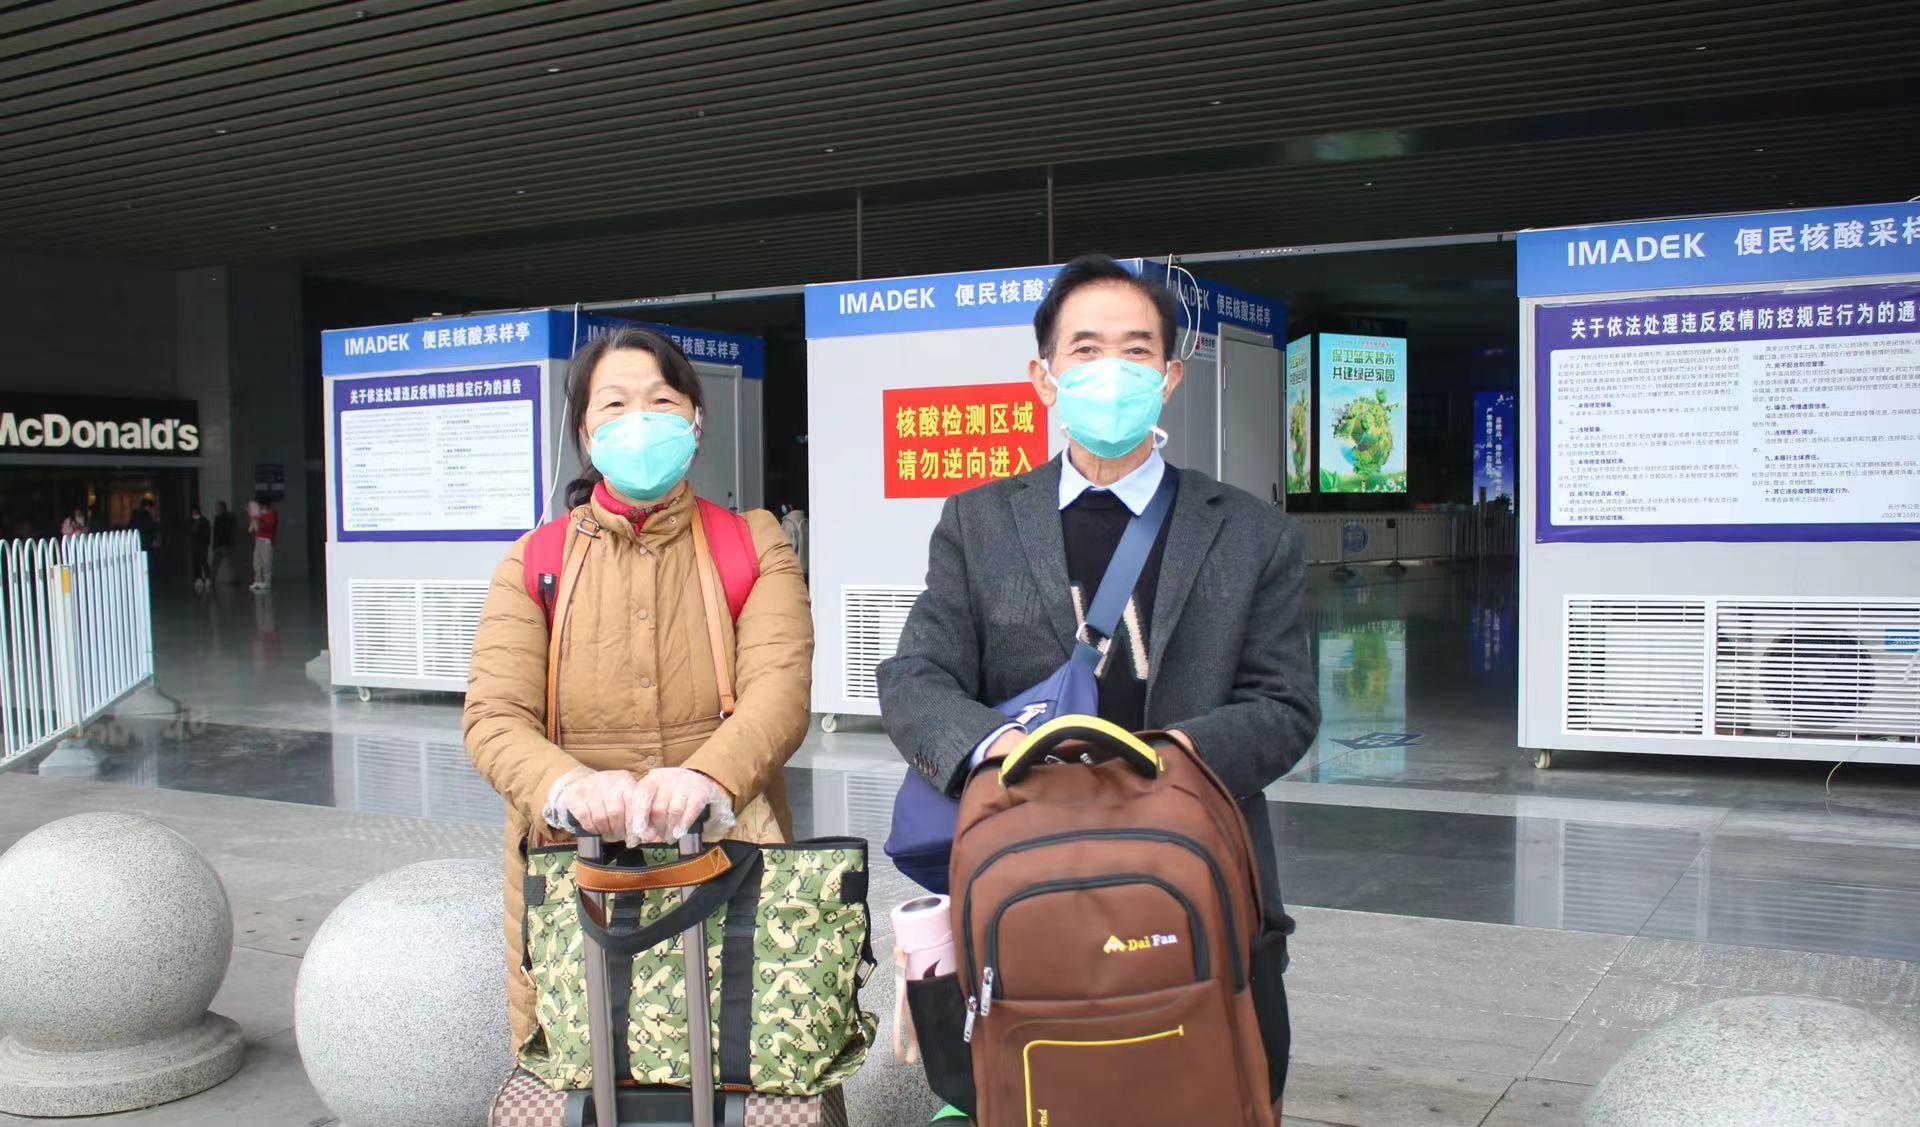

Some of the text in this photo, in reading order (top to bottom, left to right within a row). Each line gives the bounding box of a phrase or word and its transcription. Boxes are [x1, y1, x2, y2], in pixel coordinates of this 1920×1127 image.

[1567, 232, 1706, 267] IMADEK
[840, 277, 1056, 315] IMADEK 便民核酸
[1571, 299, 1920, 341] 关于依法处理违反疫情防控规定行为的通
[344, 321, 531, 357] IMADEK 便民核酸采样亭
[1332, 349, 1395, 365] 保卫蓝天碧水
[1332, 366, 1395, 382] 共建绿色家园
[350, 377, 522, 405] 关于依法处理违反疫情防控规定行为的通告
[896, 402, 1035, 440] 核酸检测区域
[897, 446, 1033, 481] 请勿逆向进入
[1127, 933, 1177, 951] Dai Fan
